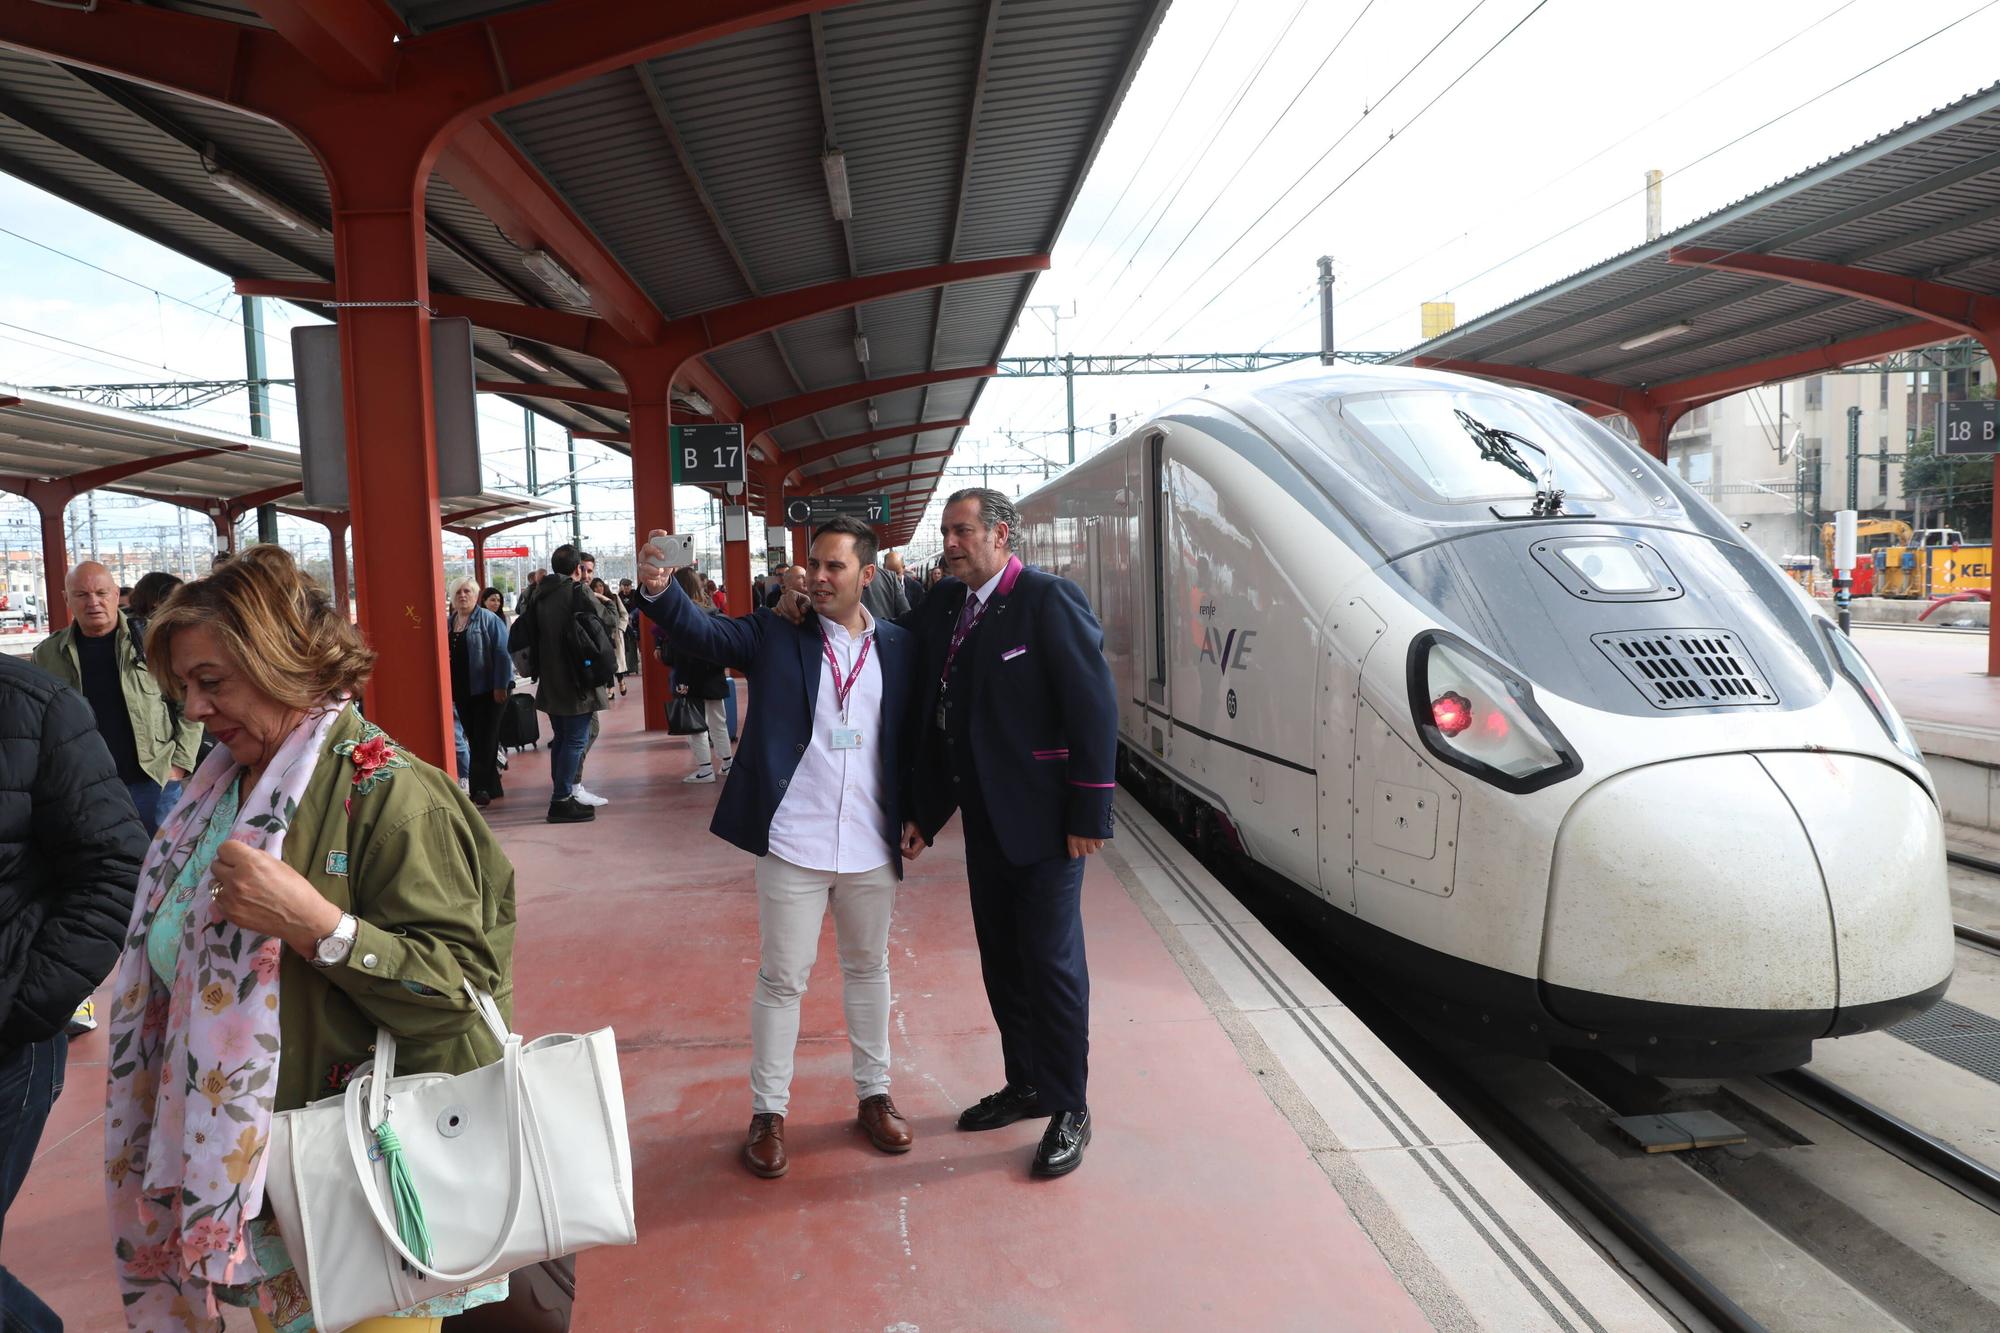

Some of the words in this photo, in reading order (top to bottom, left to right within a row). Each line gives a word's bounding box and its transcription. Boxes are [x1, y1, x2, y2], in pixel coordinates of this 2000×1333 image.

[1949, 421, 1971, 441] 18
[1983, 421, 1995, 441] B
[684, 447, 698, 469] B
[713, 446, 738, 468] 17
[867, 506, 882, 520] 17
[1200, 600, 1216, 621] renfe
[1200, 627, 1257, 677] AVE
